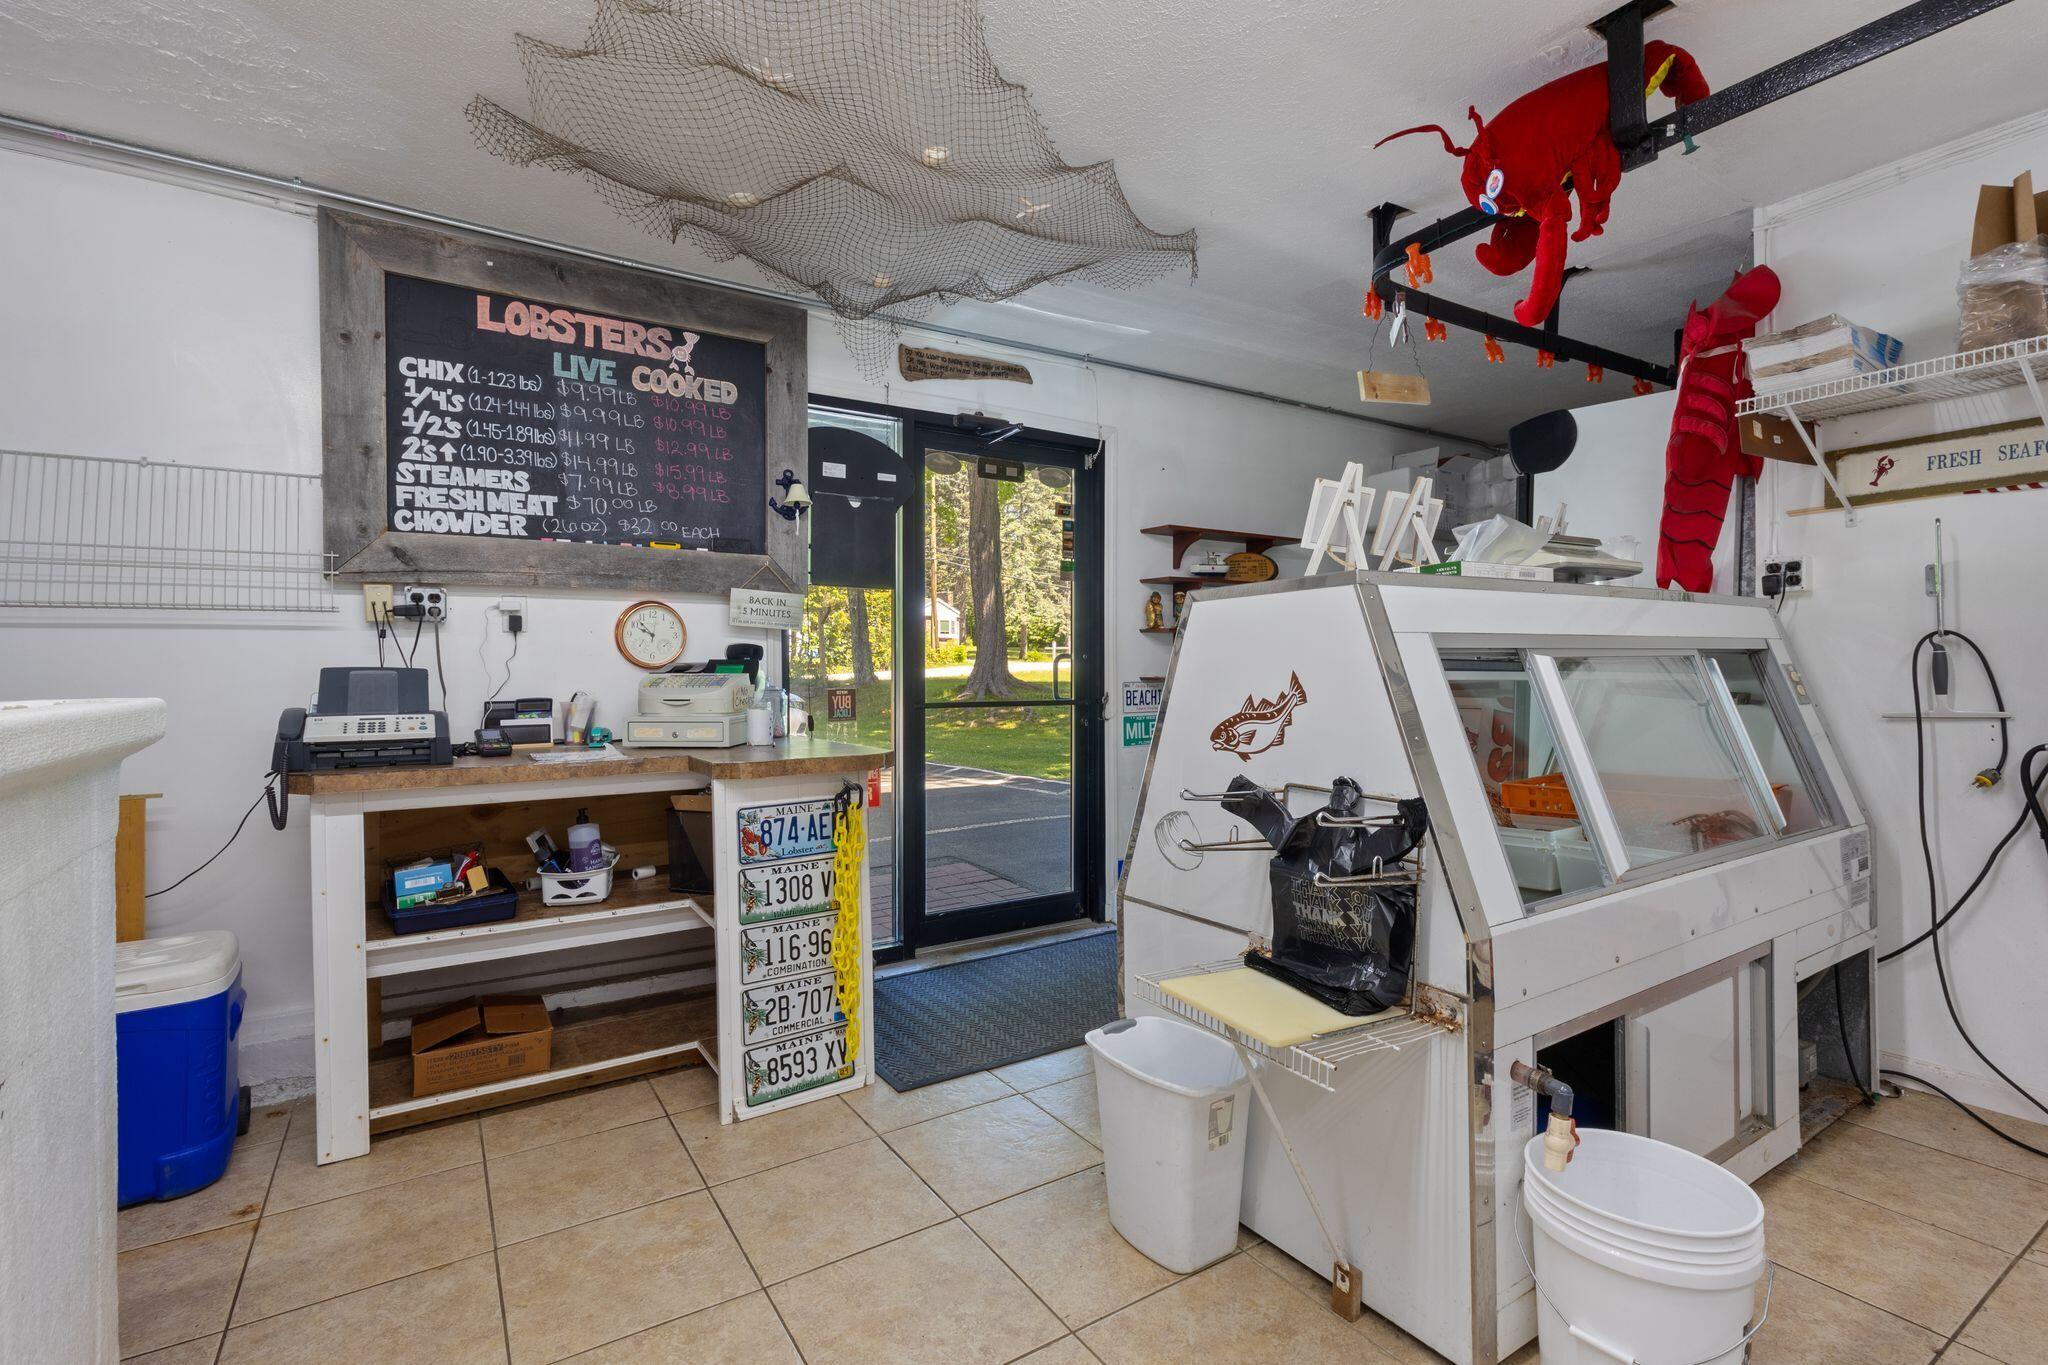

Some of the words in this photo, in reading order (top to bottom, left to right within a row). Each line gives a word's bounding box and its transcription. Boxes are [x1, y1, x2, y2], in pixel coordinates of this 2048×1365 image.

[476, 295, 673, 361] LOBSTERS
[553, 351, 617, 386] LIVE
[631, 365, 738, 405] COOKED
[398, 356, 465, 384] CHIX
[519, 374, 542, 392] lbs)
[557, 378, 617, 405] $9.99
[618, 390, 637, 406] LB
[651, 394, 708, 417] $10.99
[712, 407, 733, 421] LB
[559, 402, 621, 427] $9.99
[623, 413, 645, 429] LB
[652, 415, 706, 437] $10.99
[709, 424, 728, 439] LB
[559, 427, 609, 451] $11.99
[616, 437, 636, 455] LB
[655, 437, 710, 461] $12.99
[714, 447, 735, 461] LB
[1926, 449, 1982, 472] FRESH
[1998, 439, 2048, 462] SEAF
[561, 451, 619, 475] $14.99
[621, 462, 638, 478] LB
[655, 461, 705, 482] $15.99
[708, 470, 728, 484] LB
[396, 461, 531, 493] STEAMERS
[558, 472, 614, 495] $7.99
[617, 481, 638, 497] LB
[653, 481, 707, 502] $8.99
[710, 489, 730, 503] LB
[395, 484, 485, 512] FRESH
[487, 491, 559, 517] MEAT
[566, 494, 634, 516] $70.00
[638, 499, 658, 513] LB
[393, 509, 528, 536] CHOWDER
[681, 526, 720, 539] EACH
[749, 596, 773, 606] BACK
[776, 598, 787, 607] IN
[649, 610, 657, 619] 12
[743, 607, 748, 615] 5
[750, 607, 791, 618] MINUTES
[669, 621, 675, 630] 2
[673, 631, 678, 639] 3
[776, 804, 814, 817] MAINE
[781, 845, 814, 856] Lobster
[771, 862, 820, 875] MAINE
[764, 873, 813, 907] 1308
[772, 919, 820, 933] MAINE
[767, 958, 827, 977] COMBINATION
[774, 976, 822, 993] MAINE
[772, 1017, 825, 1036] COMMERCIAL
[775, 1033, 823, 1053] MAINE
[767, 1046, 818, 1086] 8593
[779, 1076, 825, 1096] Vacationland
